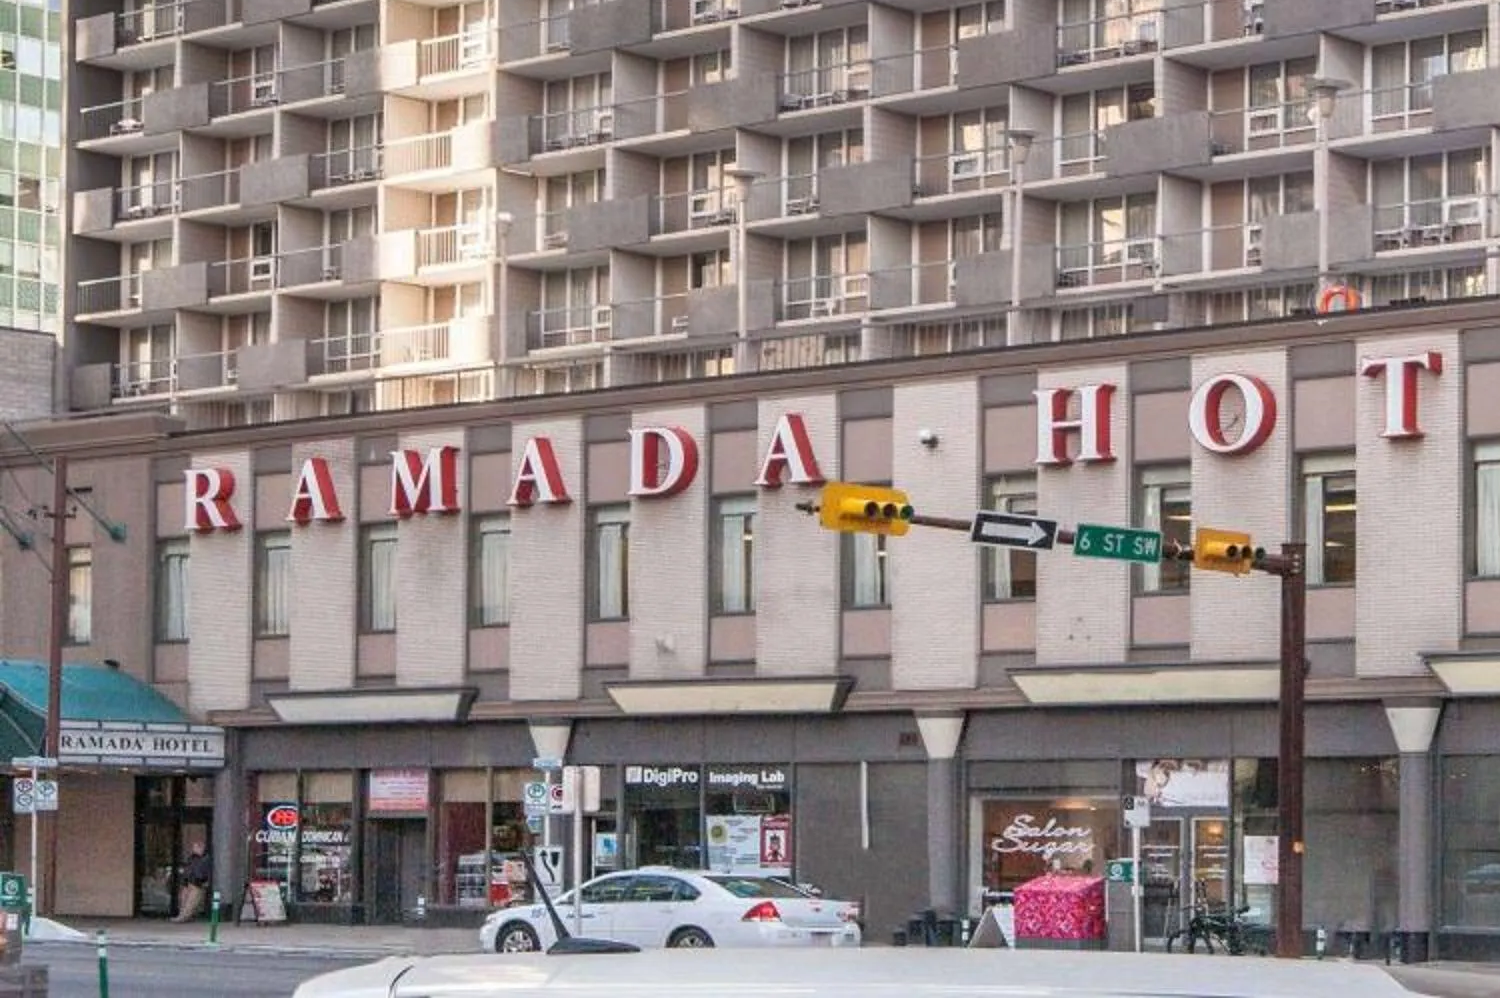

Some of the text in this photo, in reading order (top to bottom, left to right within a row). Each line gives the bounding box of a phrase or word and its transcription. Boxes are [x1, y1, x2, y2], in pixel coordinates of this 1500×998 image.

[183, 412, 826, 532] RAMADA
[1079, 531, 1157, 556] 6 ST SW
[61, 735, 214, 752] RAMADA HOTEL
[643, 767, 699, 787] DigiPro
[709, 770, 785, 786] Imaging Lab
[255, 829, 297, 843] CUBAN
[1002, 814, 1092, 838] Salon
[991, 836, 1095, 859] Sugar
